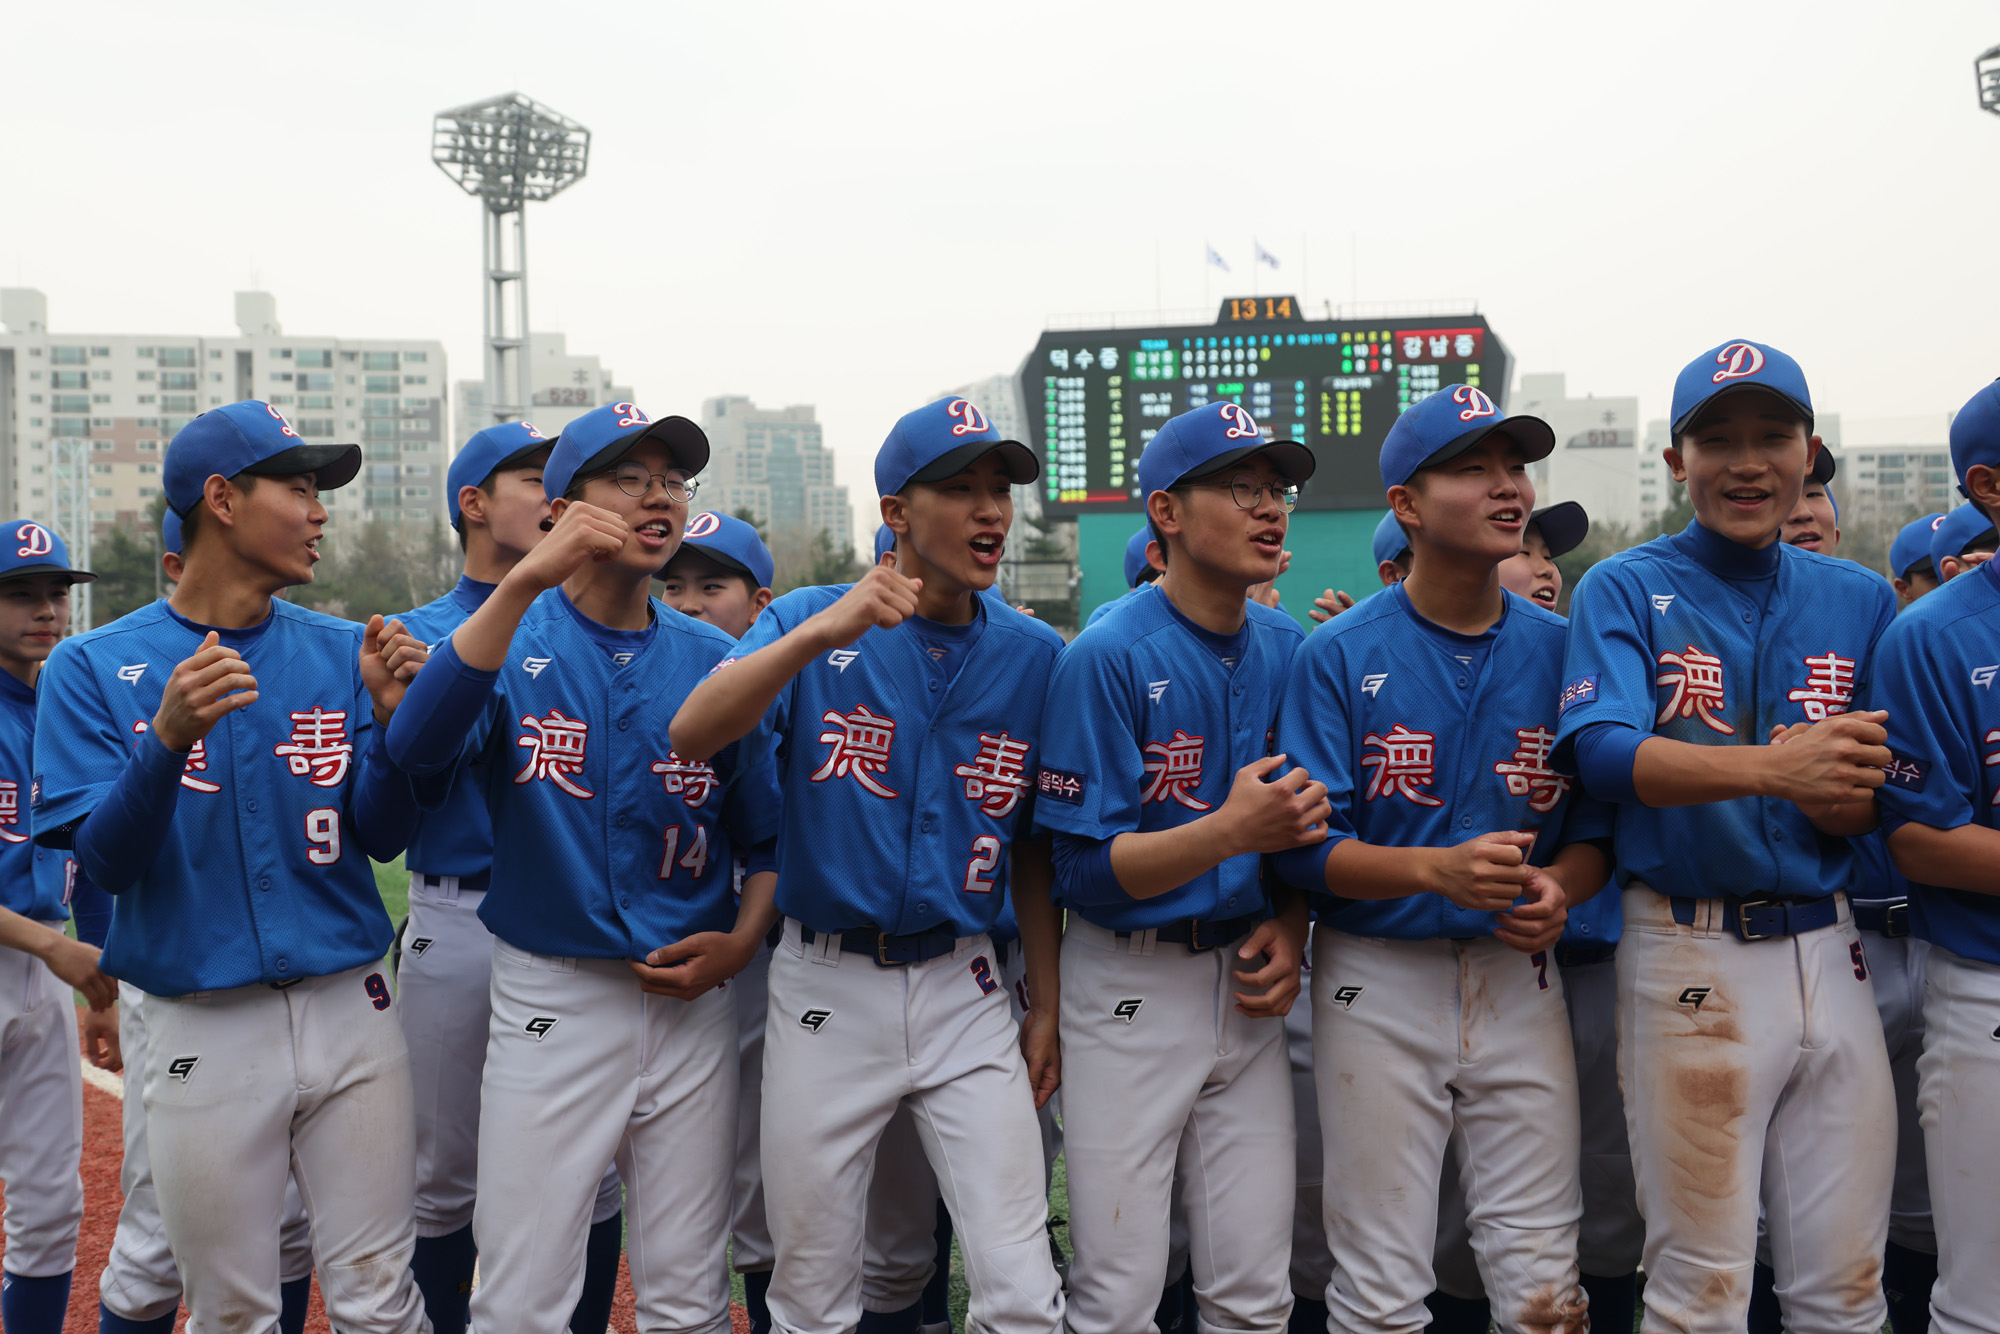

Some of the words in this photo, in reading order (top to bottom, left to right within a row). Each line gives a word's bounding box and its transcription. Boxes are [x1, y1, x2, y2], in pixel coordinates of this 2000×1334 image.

[1230, 299, 1257, 320] 13
[1265, 297, 1291, 319] 14
[1712, 342, 1765, 384] D
[946, 398, 989, 437] D
[1219, 403, 1259, 439] D
[1452, 385, 1496, 422] D
[15, 523, 52, 558] D
[305, 806, 342, 866] 9
[658, 824, 709, 880] 14
[963, 834, 1001, 893] 2
[970, 956, 998, 995] 2
[1531, 950, 1549, 990] 7
[1849, 938, 1871, 982] 5
[364, 972, 391, 1011] 9
